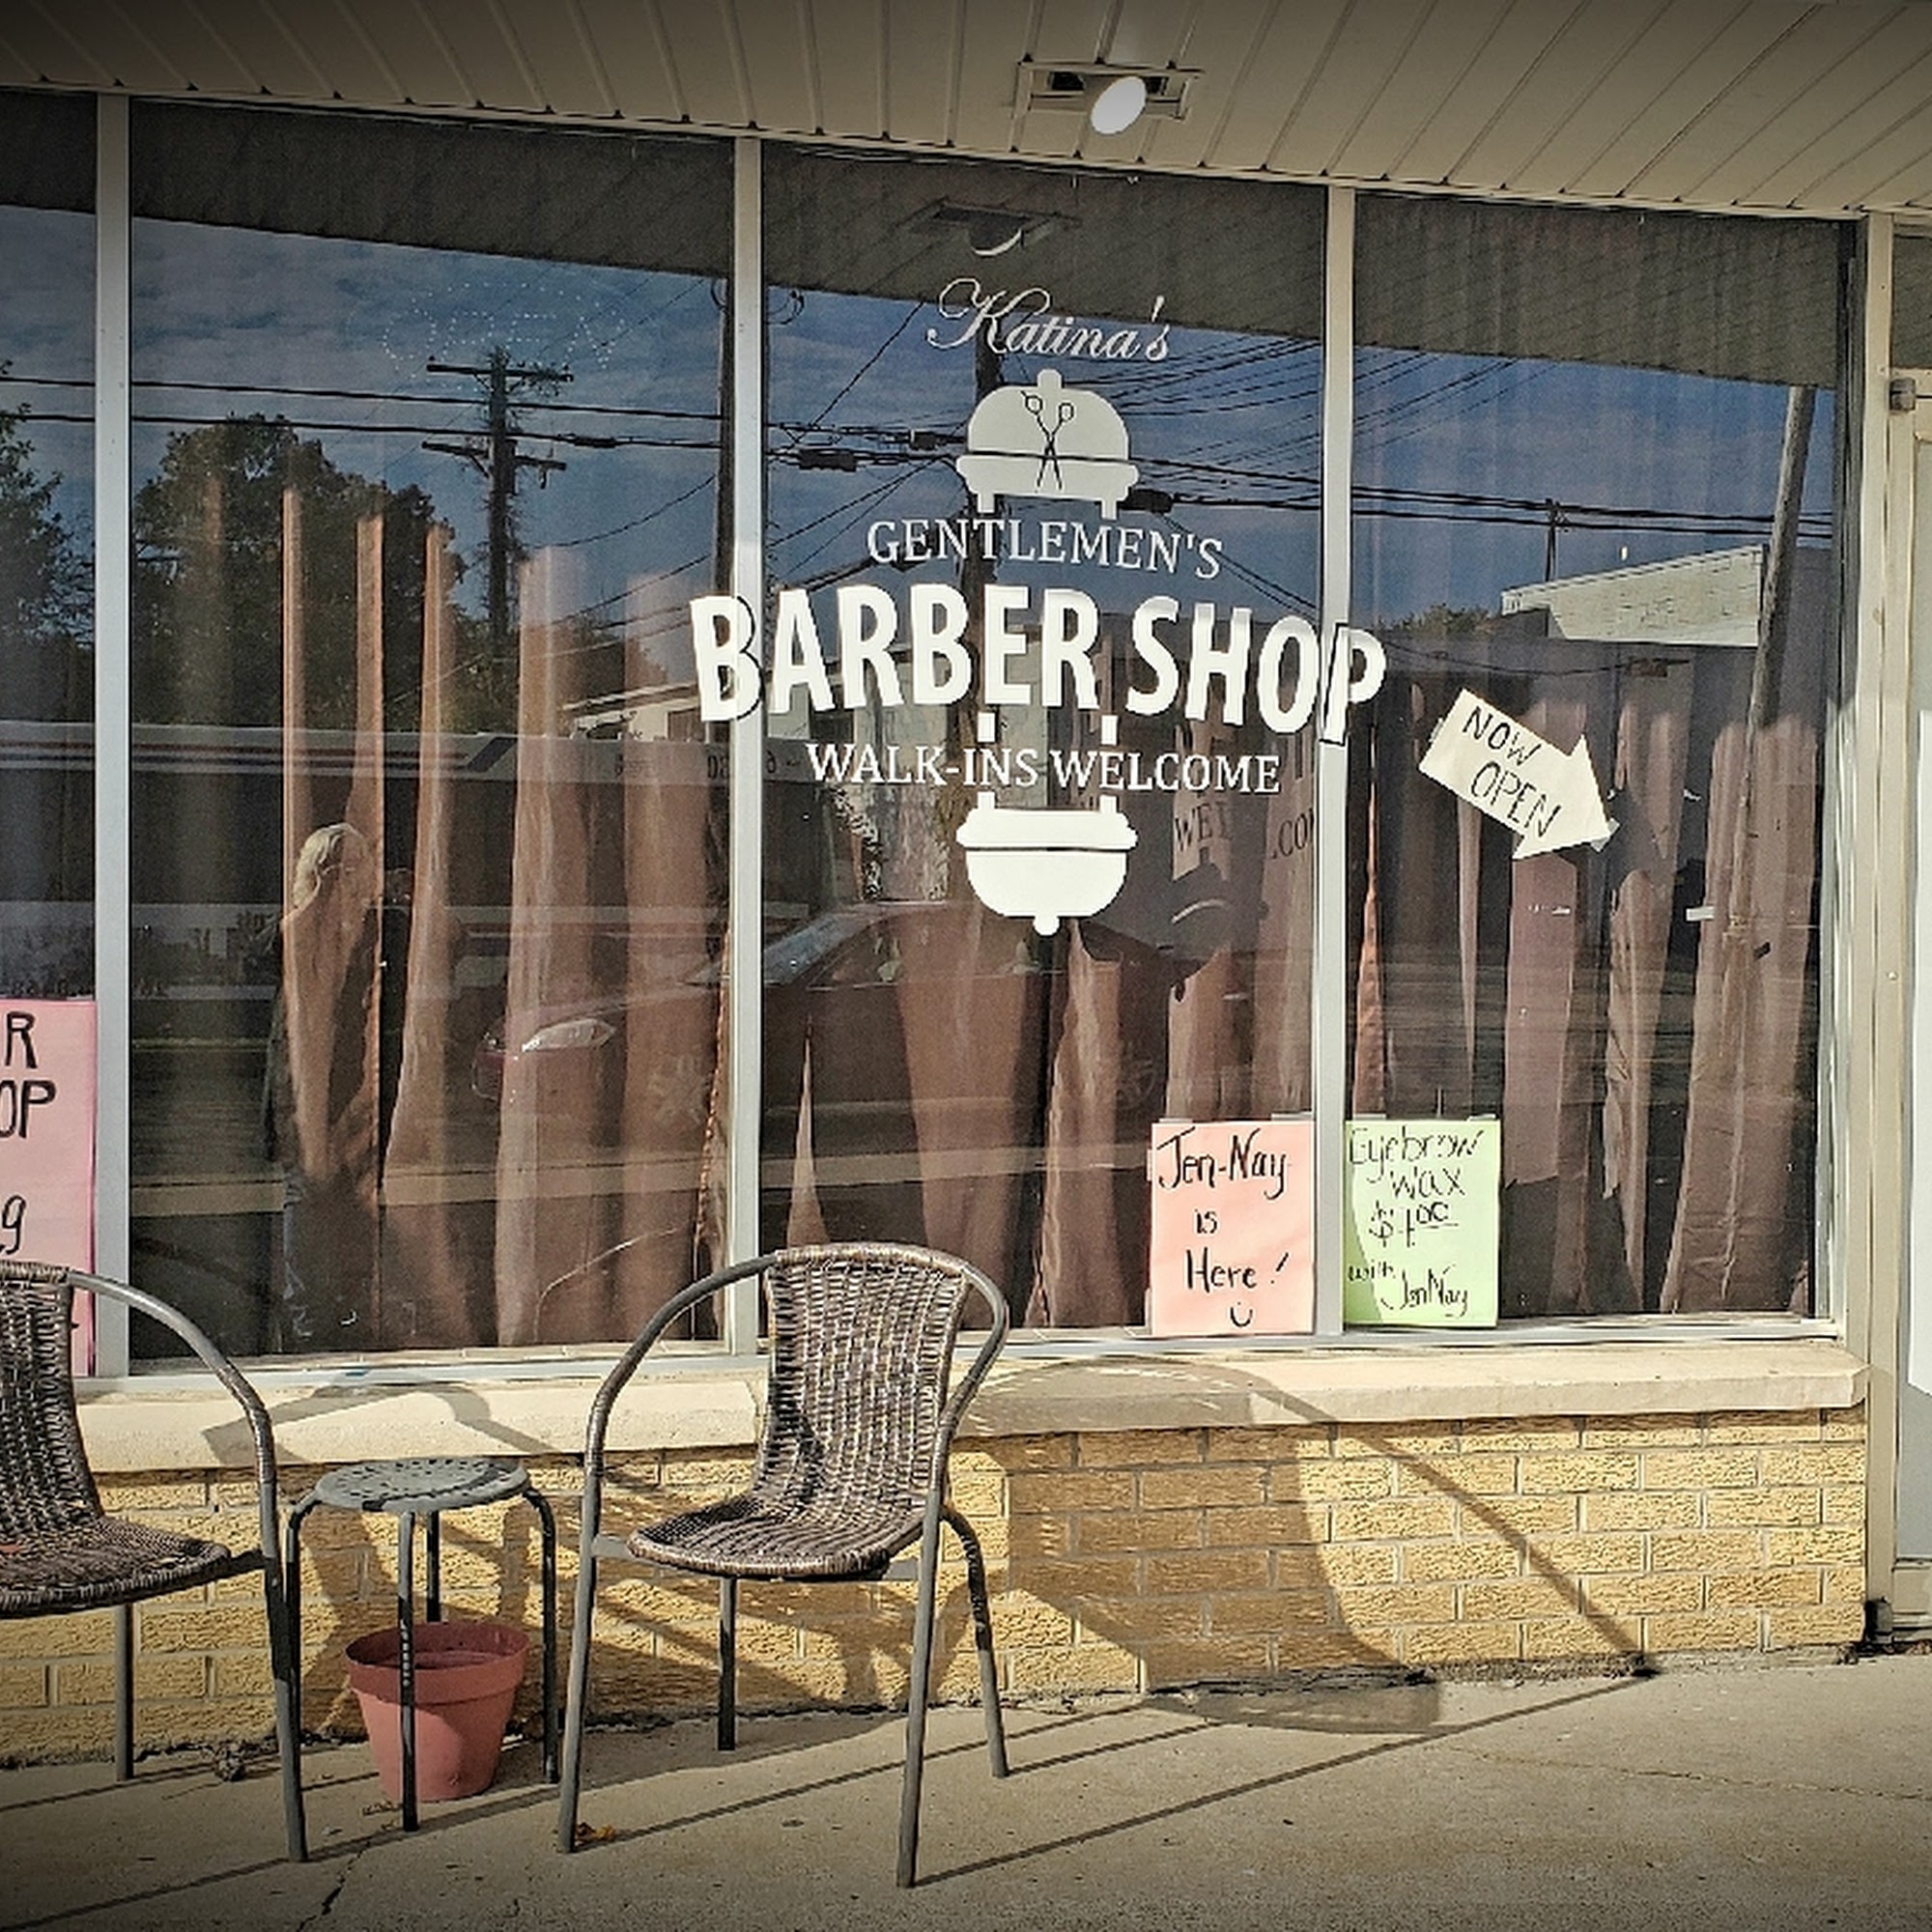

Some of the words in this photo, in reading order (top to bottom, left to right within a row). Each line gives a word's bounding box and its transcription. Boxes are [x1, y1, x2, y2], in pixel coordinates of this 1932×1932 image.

[927, 278, 1170, 361] Katina's
[867, 518, 1223, 580] GENTLEMEN'S
[690, 583, 1101, 723] BARBER
[1126, 596, 1387, 746] SHOP
[1463, 705, 1542, 766] NOW
[806, 744, 1039, 789] WALK-INS
[1049, 750, 1280, 794] WELCOME
[1469, 760, 1562, 838] OPEN
[1156, 1126, 1288, 1200] Jen-Nay
[1349, 1125, 1485, 1183] Eyebrow
[1349, 1260, 1396, 1282] with
